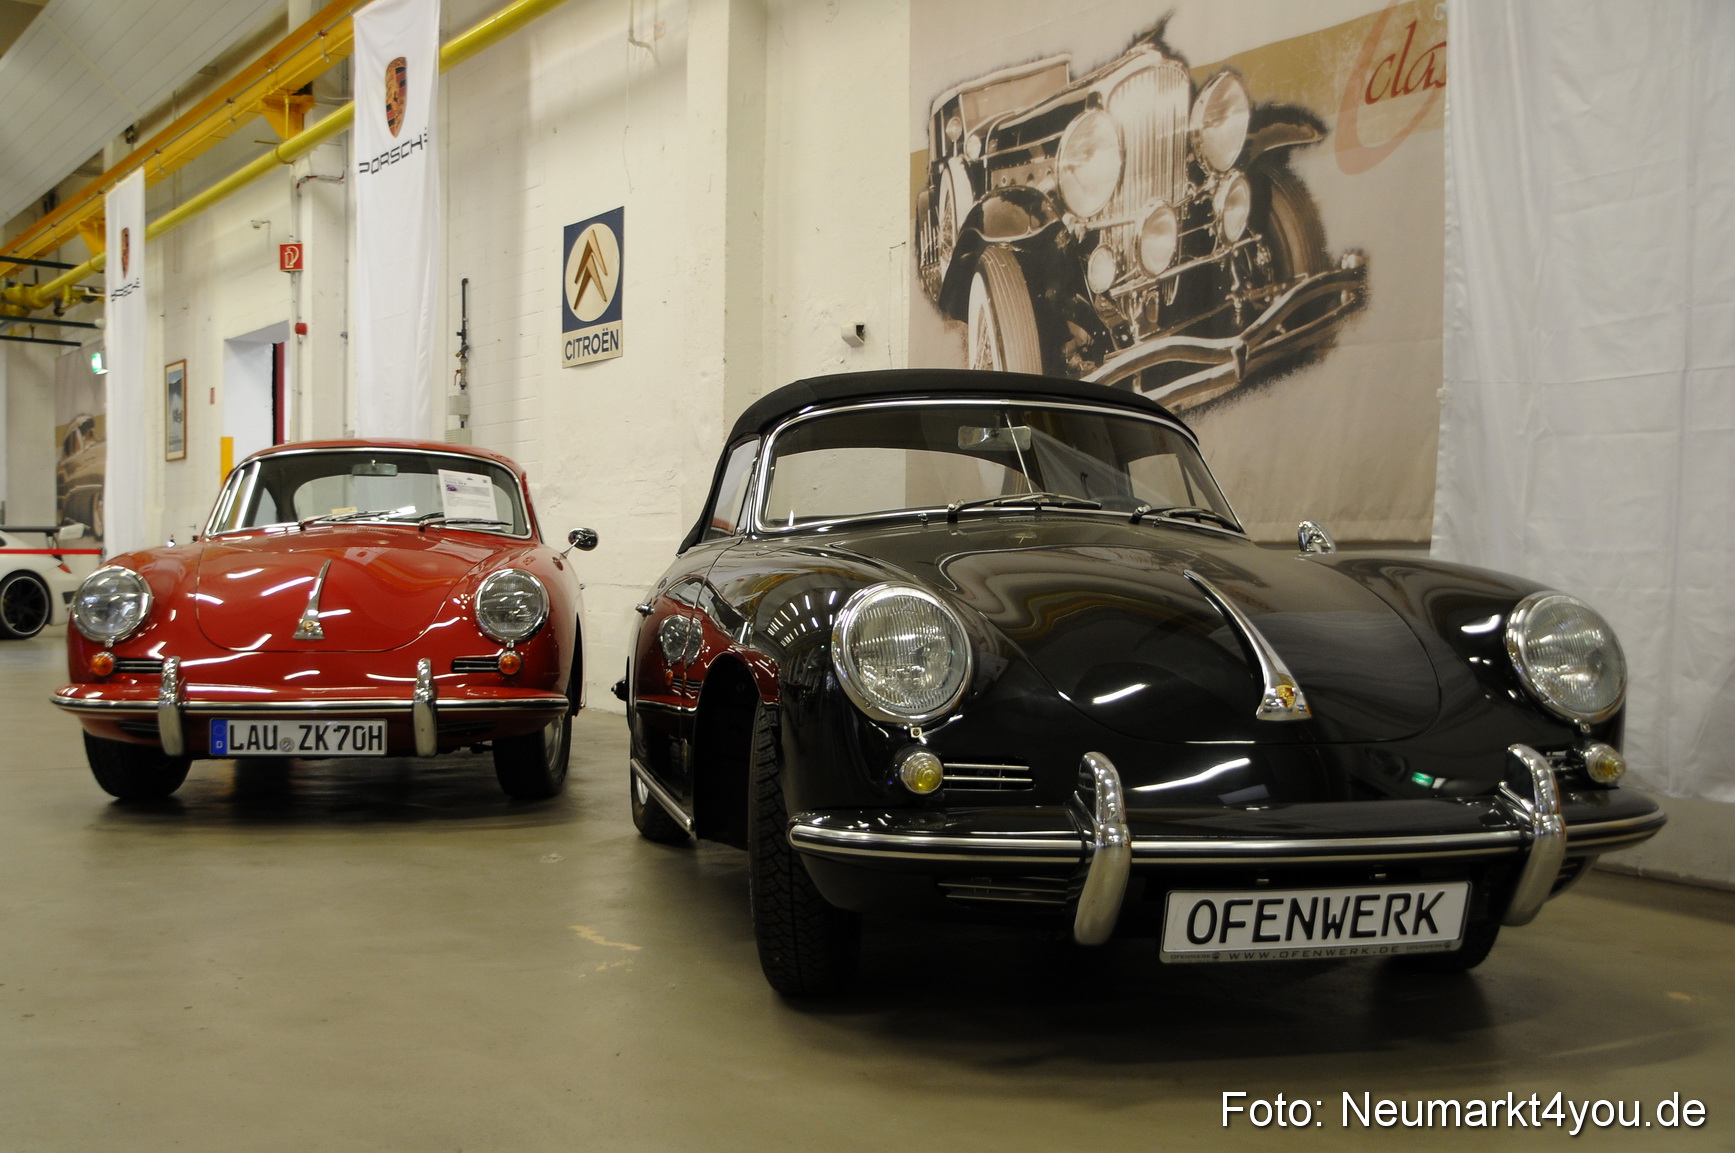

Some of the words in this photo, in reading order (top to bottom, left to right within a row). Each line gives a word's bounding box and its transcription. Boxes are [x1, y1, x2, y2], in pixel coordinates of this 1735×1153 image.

[565, 328, 619, 361] CITROËN
[230, 725, 278, 750] LAU
[1187, 891, 1446, 945] OFENWERK
[1229, 946, 1399, 960] WWW.OFENWERK.DE
